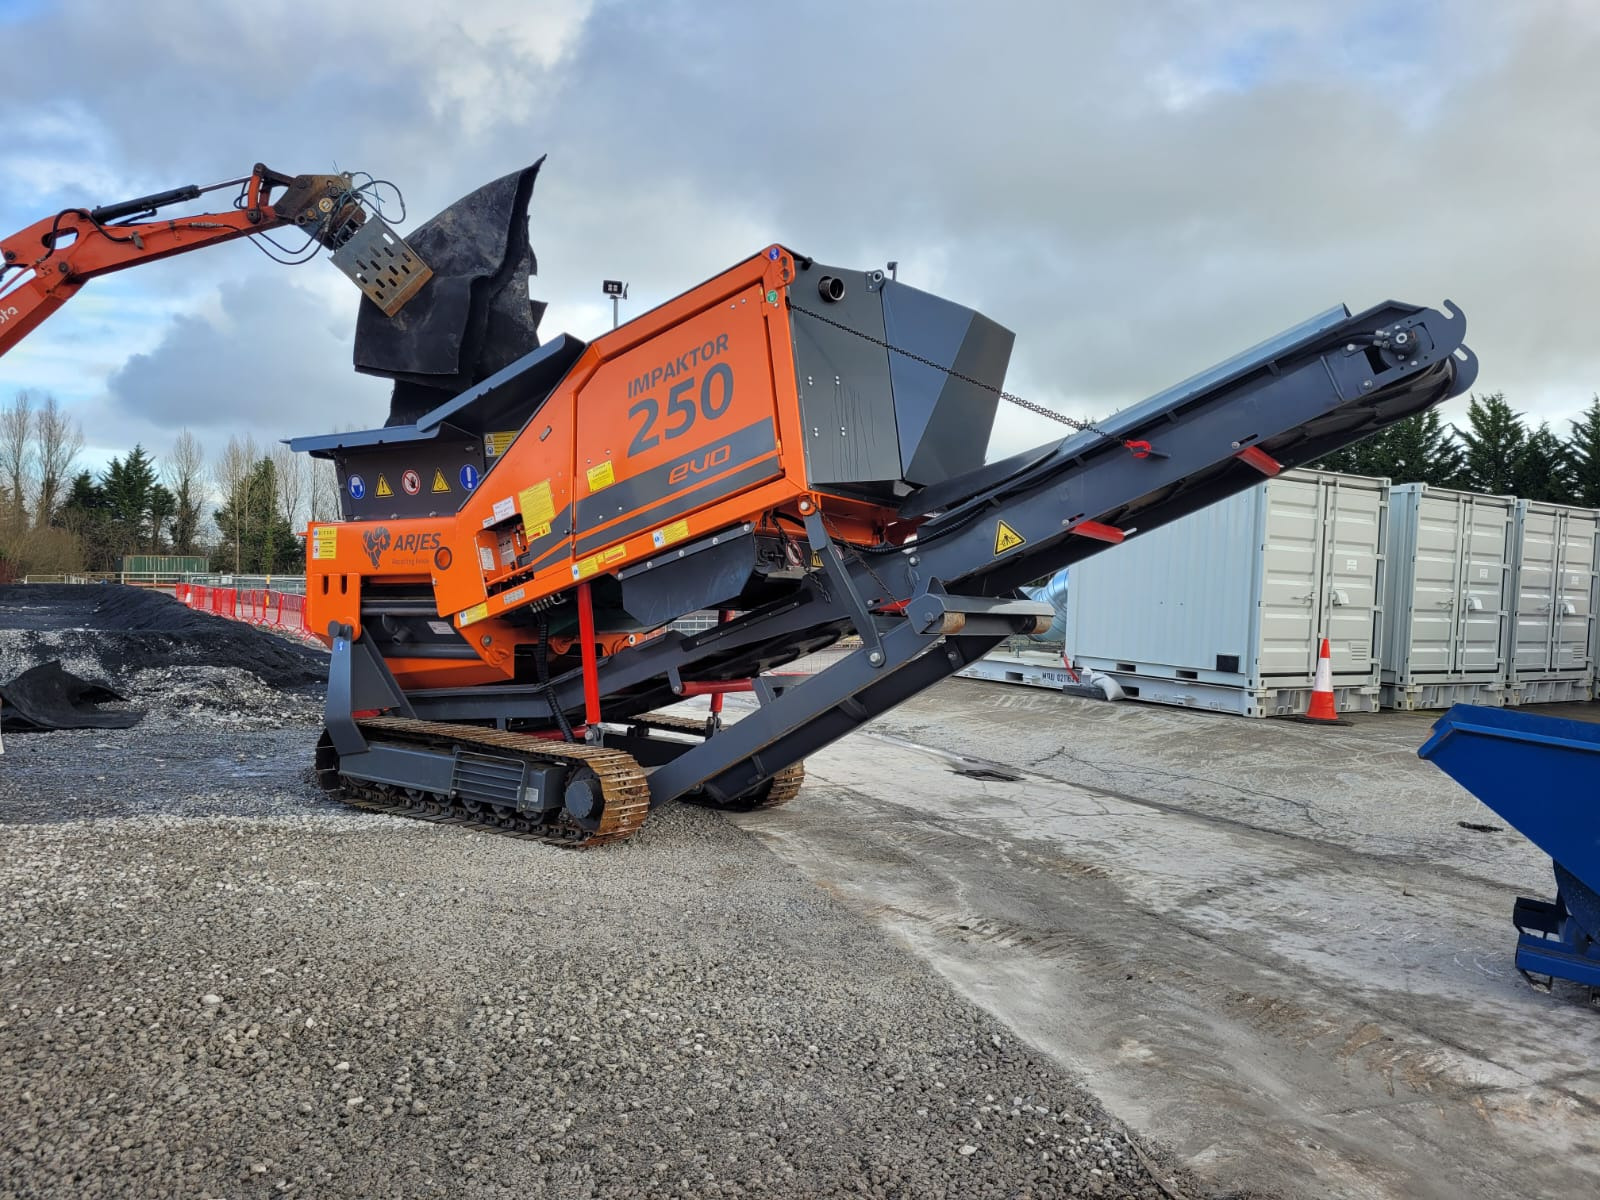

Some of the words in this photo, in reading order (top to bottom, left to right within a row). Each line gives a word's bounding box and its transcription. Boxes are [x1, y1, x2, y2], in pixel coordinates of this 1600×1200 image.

[628, 333, 729, 399] IMPAKTOR
[627, 362, 734, 459] 250
[393, 532, 442, 555] ARJES
